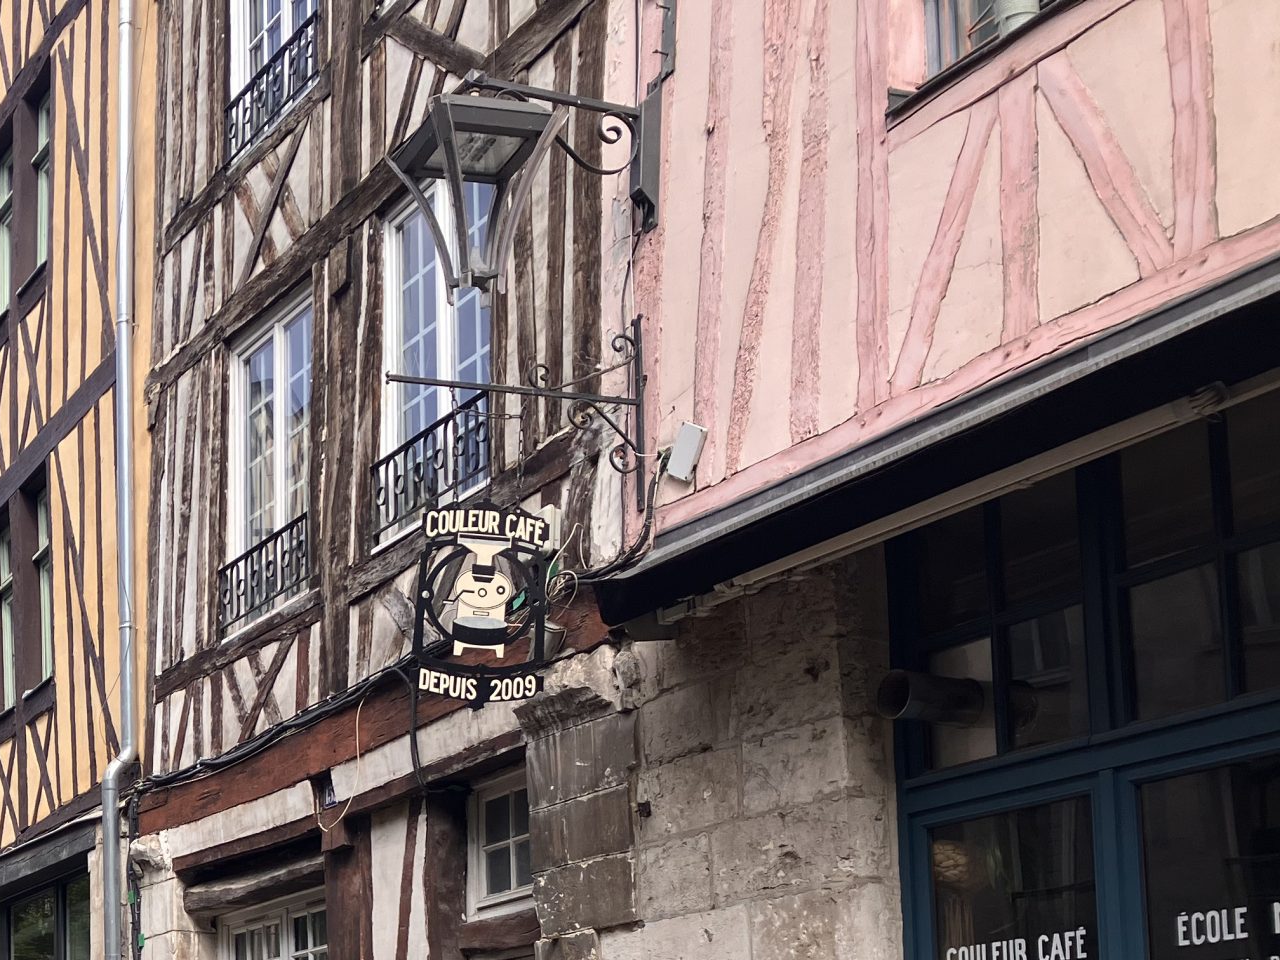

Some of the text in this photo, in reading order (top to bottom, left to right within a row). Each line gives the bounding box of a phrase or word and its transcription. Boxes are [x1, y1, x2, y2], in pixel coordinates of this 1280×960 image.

[426, 509, 545, 545] COULEUR CAFÉ
[418, 668, 537, 701] DEPUIS 2009
[1177, 906, 1249, 947] ÉCOLE
